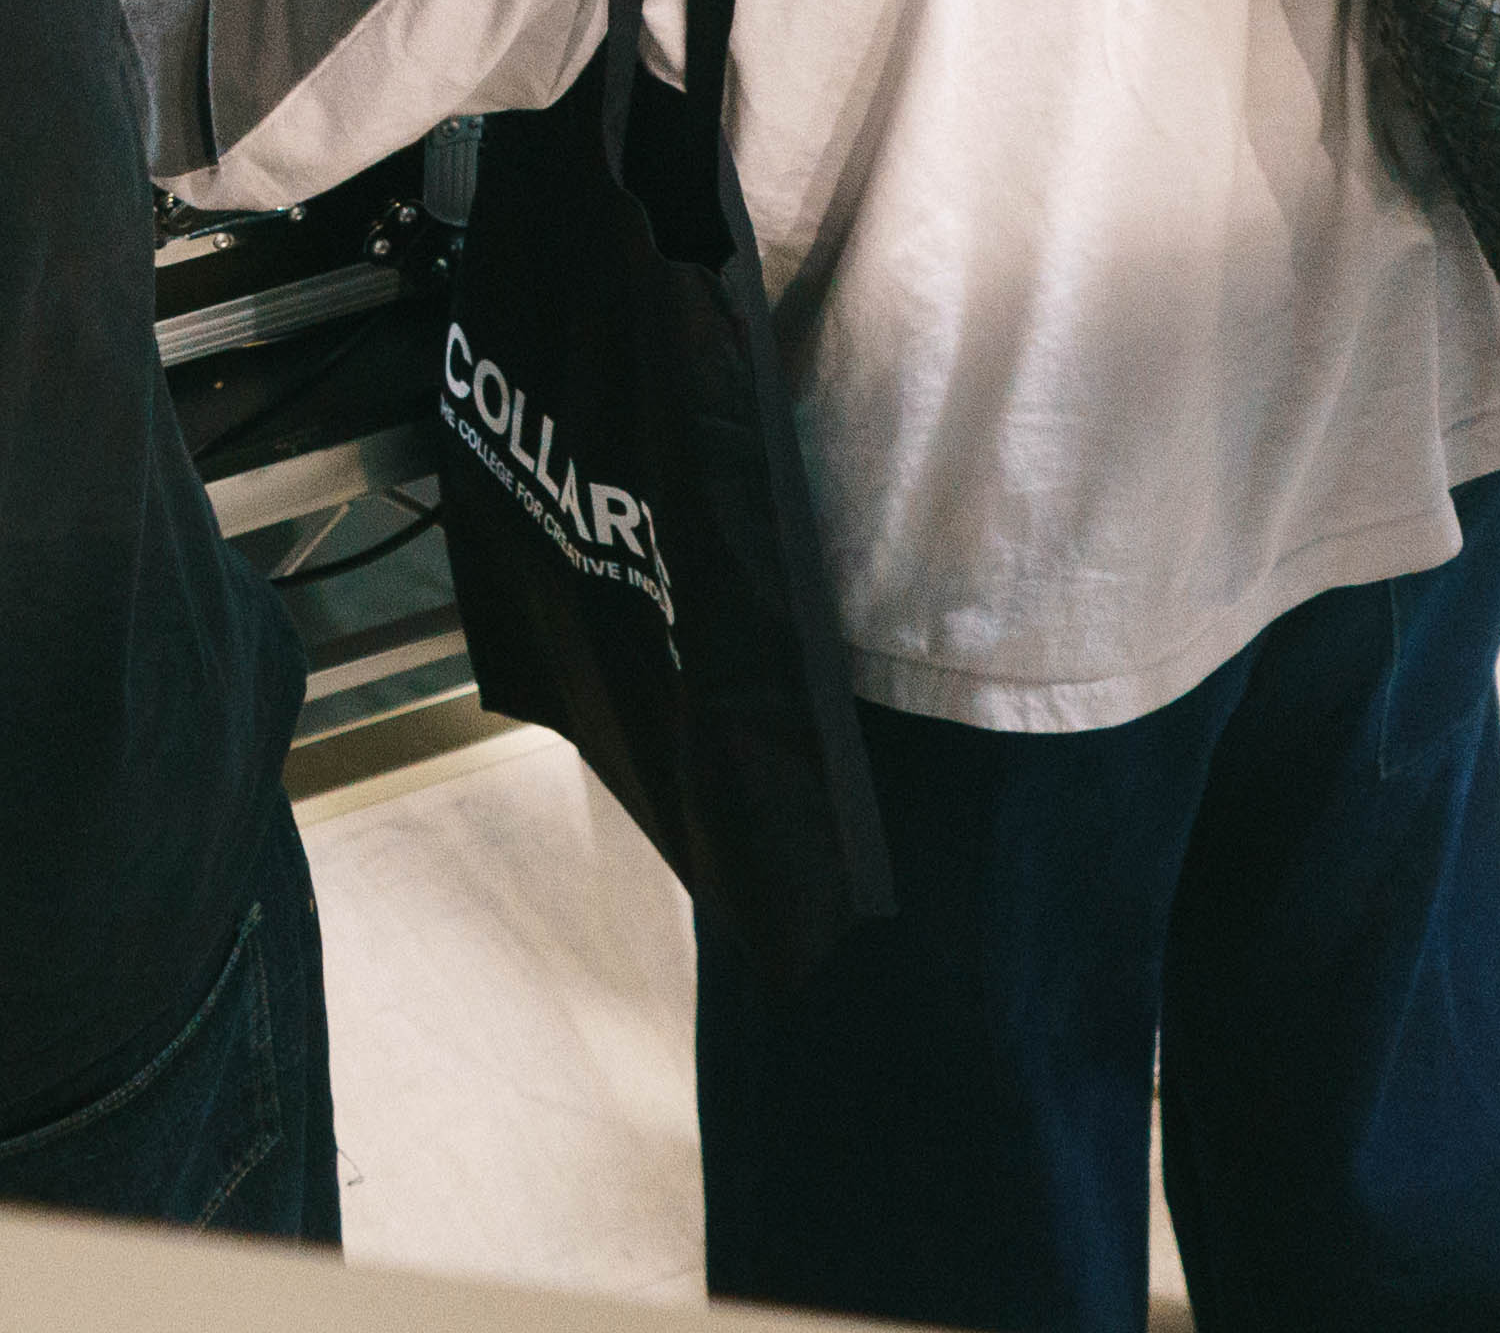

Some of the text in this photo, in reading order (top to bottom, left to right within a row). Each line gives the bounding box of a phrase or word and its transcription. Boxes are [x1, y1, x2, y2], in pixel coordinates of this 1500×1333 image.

[446, 322, 675, 626] COLLAR
[457, 419, 515, 493] COLLEGE
[516, 481, 546, 525] FOR
[543, 513, 622, 581] CREATIVE
